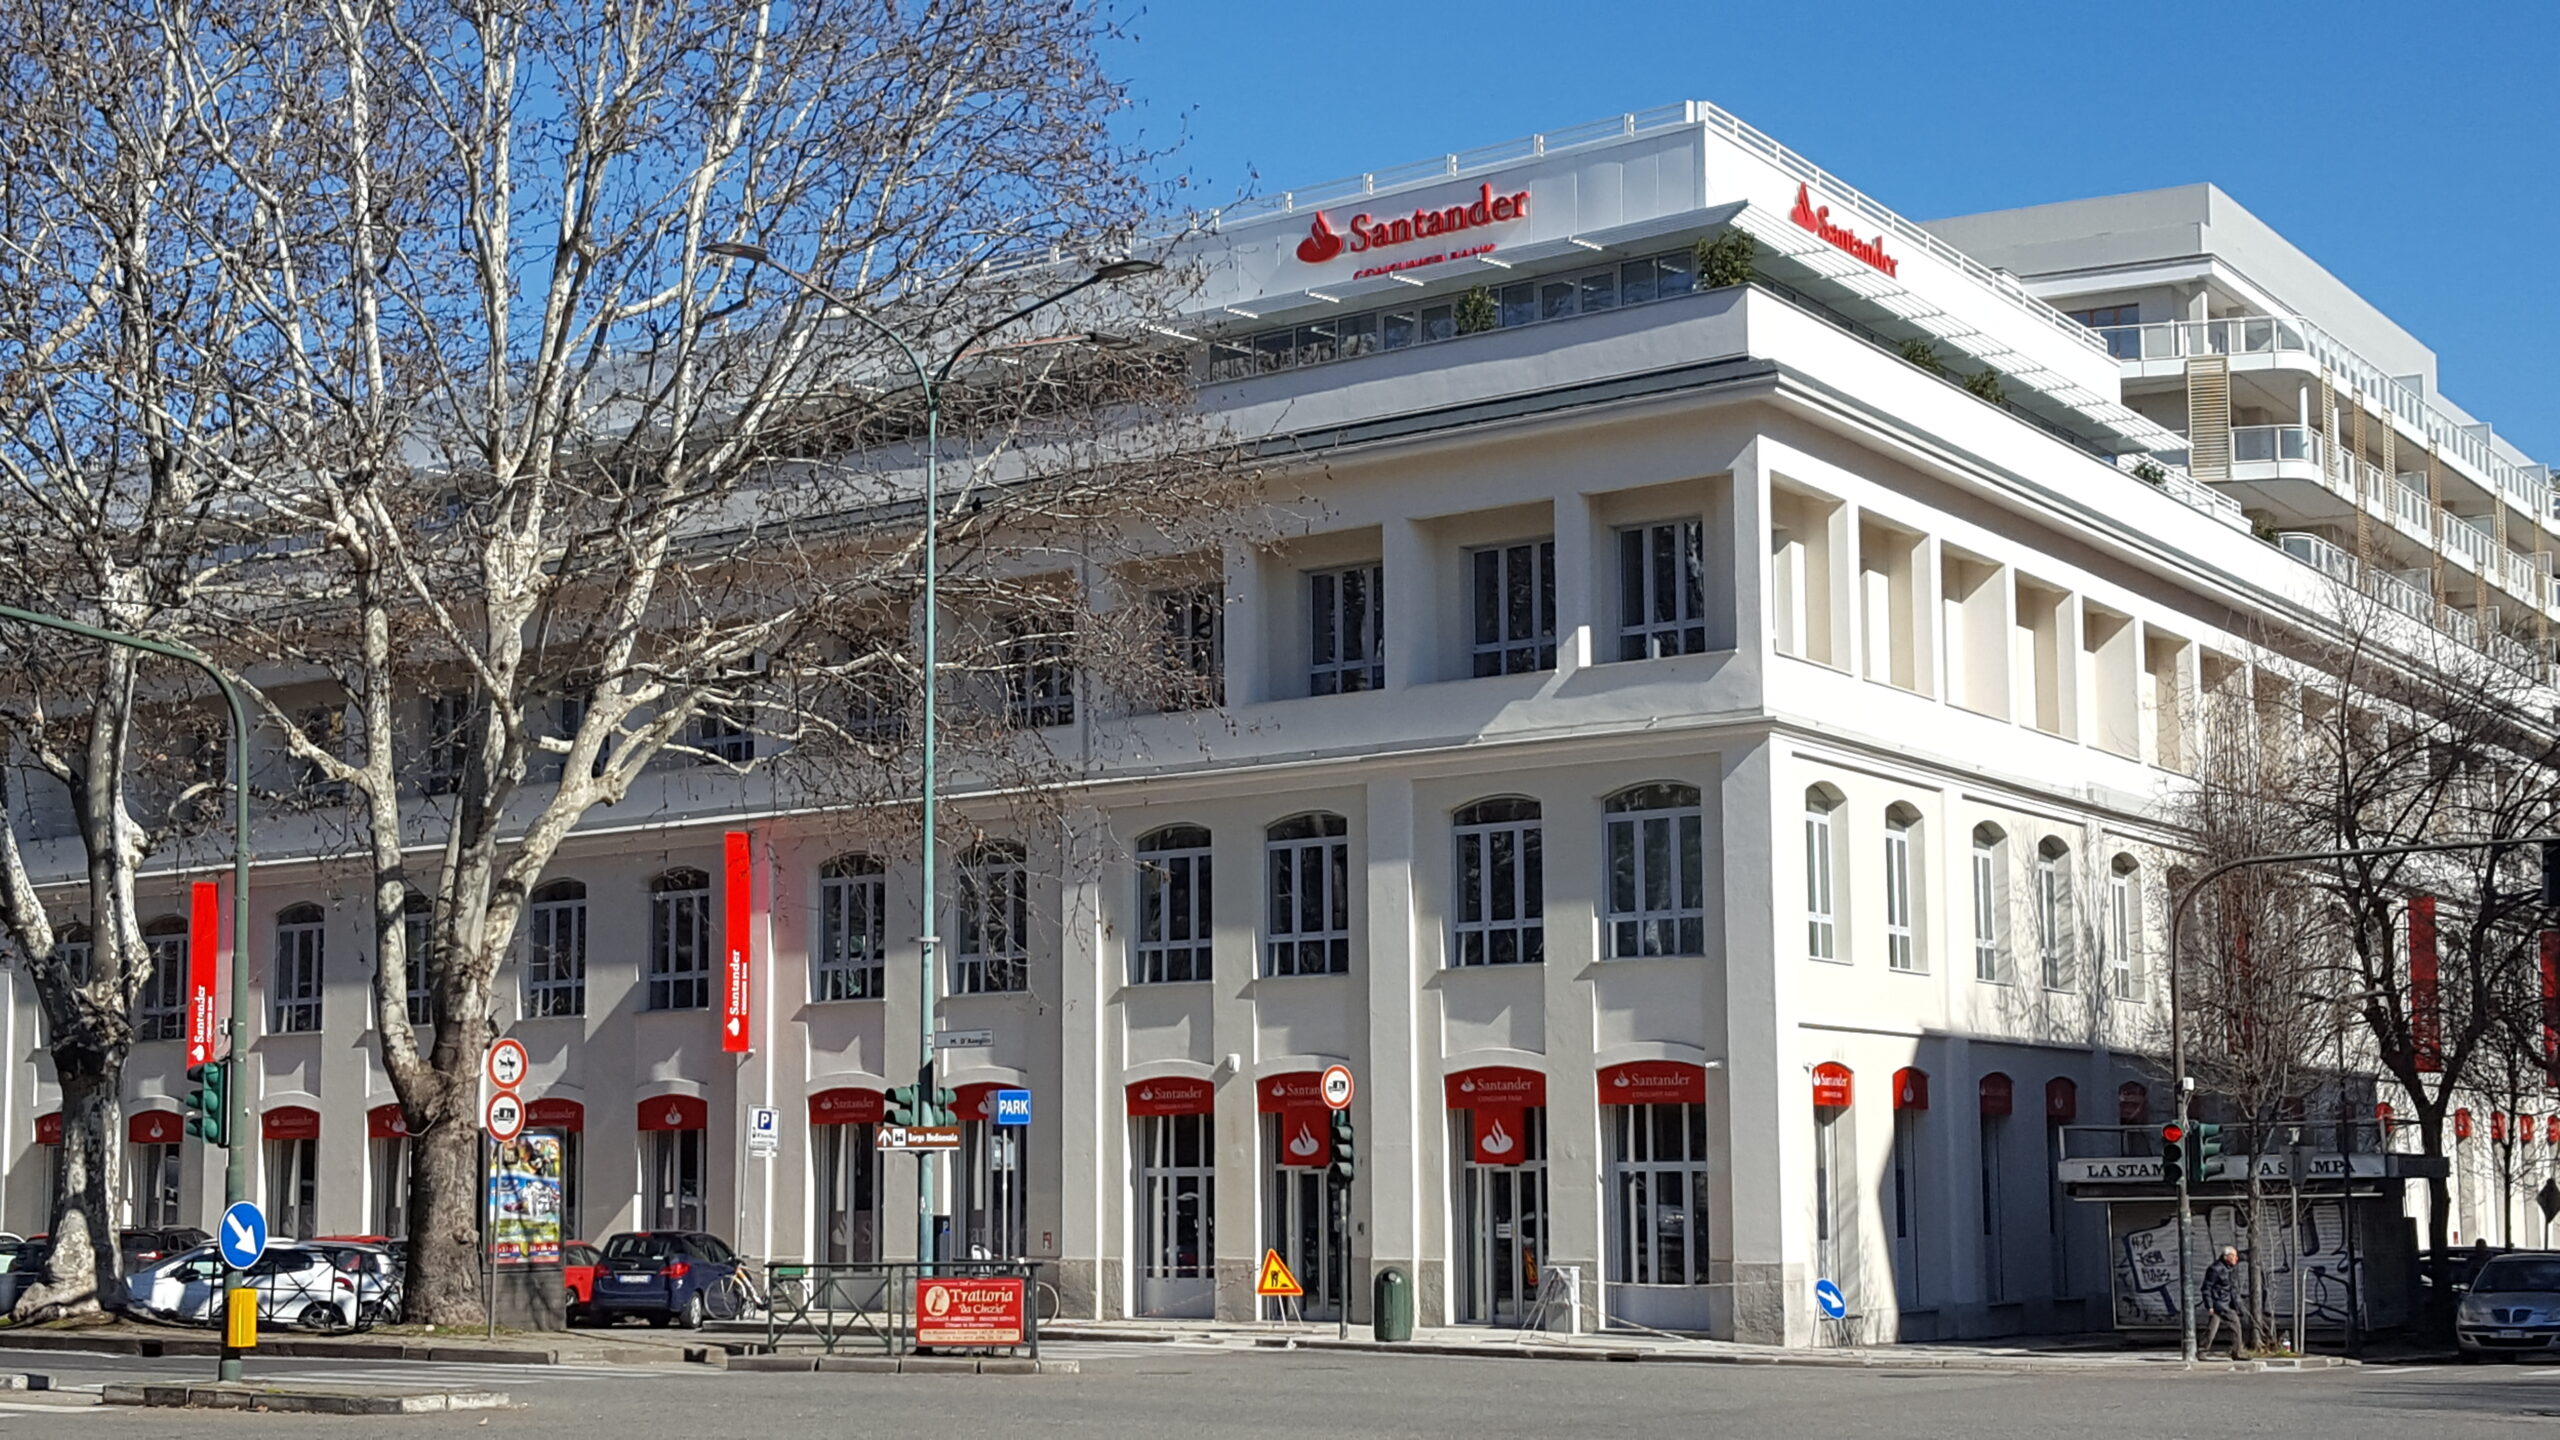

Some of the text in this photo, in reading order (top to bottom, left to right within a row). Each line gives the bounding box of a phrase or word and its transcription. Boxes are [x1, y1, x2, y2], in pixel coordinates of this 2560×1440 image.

[1350, 181, 1531, 253] Santander
[1816, 205, 1899, 280] Santander
[730, 948, 741, 1016] Santander
[193, 984, 206, 1044] Santander
[1477, 1076, 1533, 1092] Santander
[1631, 1071, 1690, 1087] Santander
[1154, 1085, 1204, 1100] Santander
[1000, 1099, 1029, 1115] PARK
[760, 1112, 771, 1128] P
[2087, 1164, 2112, 1178] LA
[949, 1286, 1014, 1303] Trattoria
